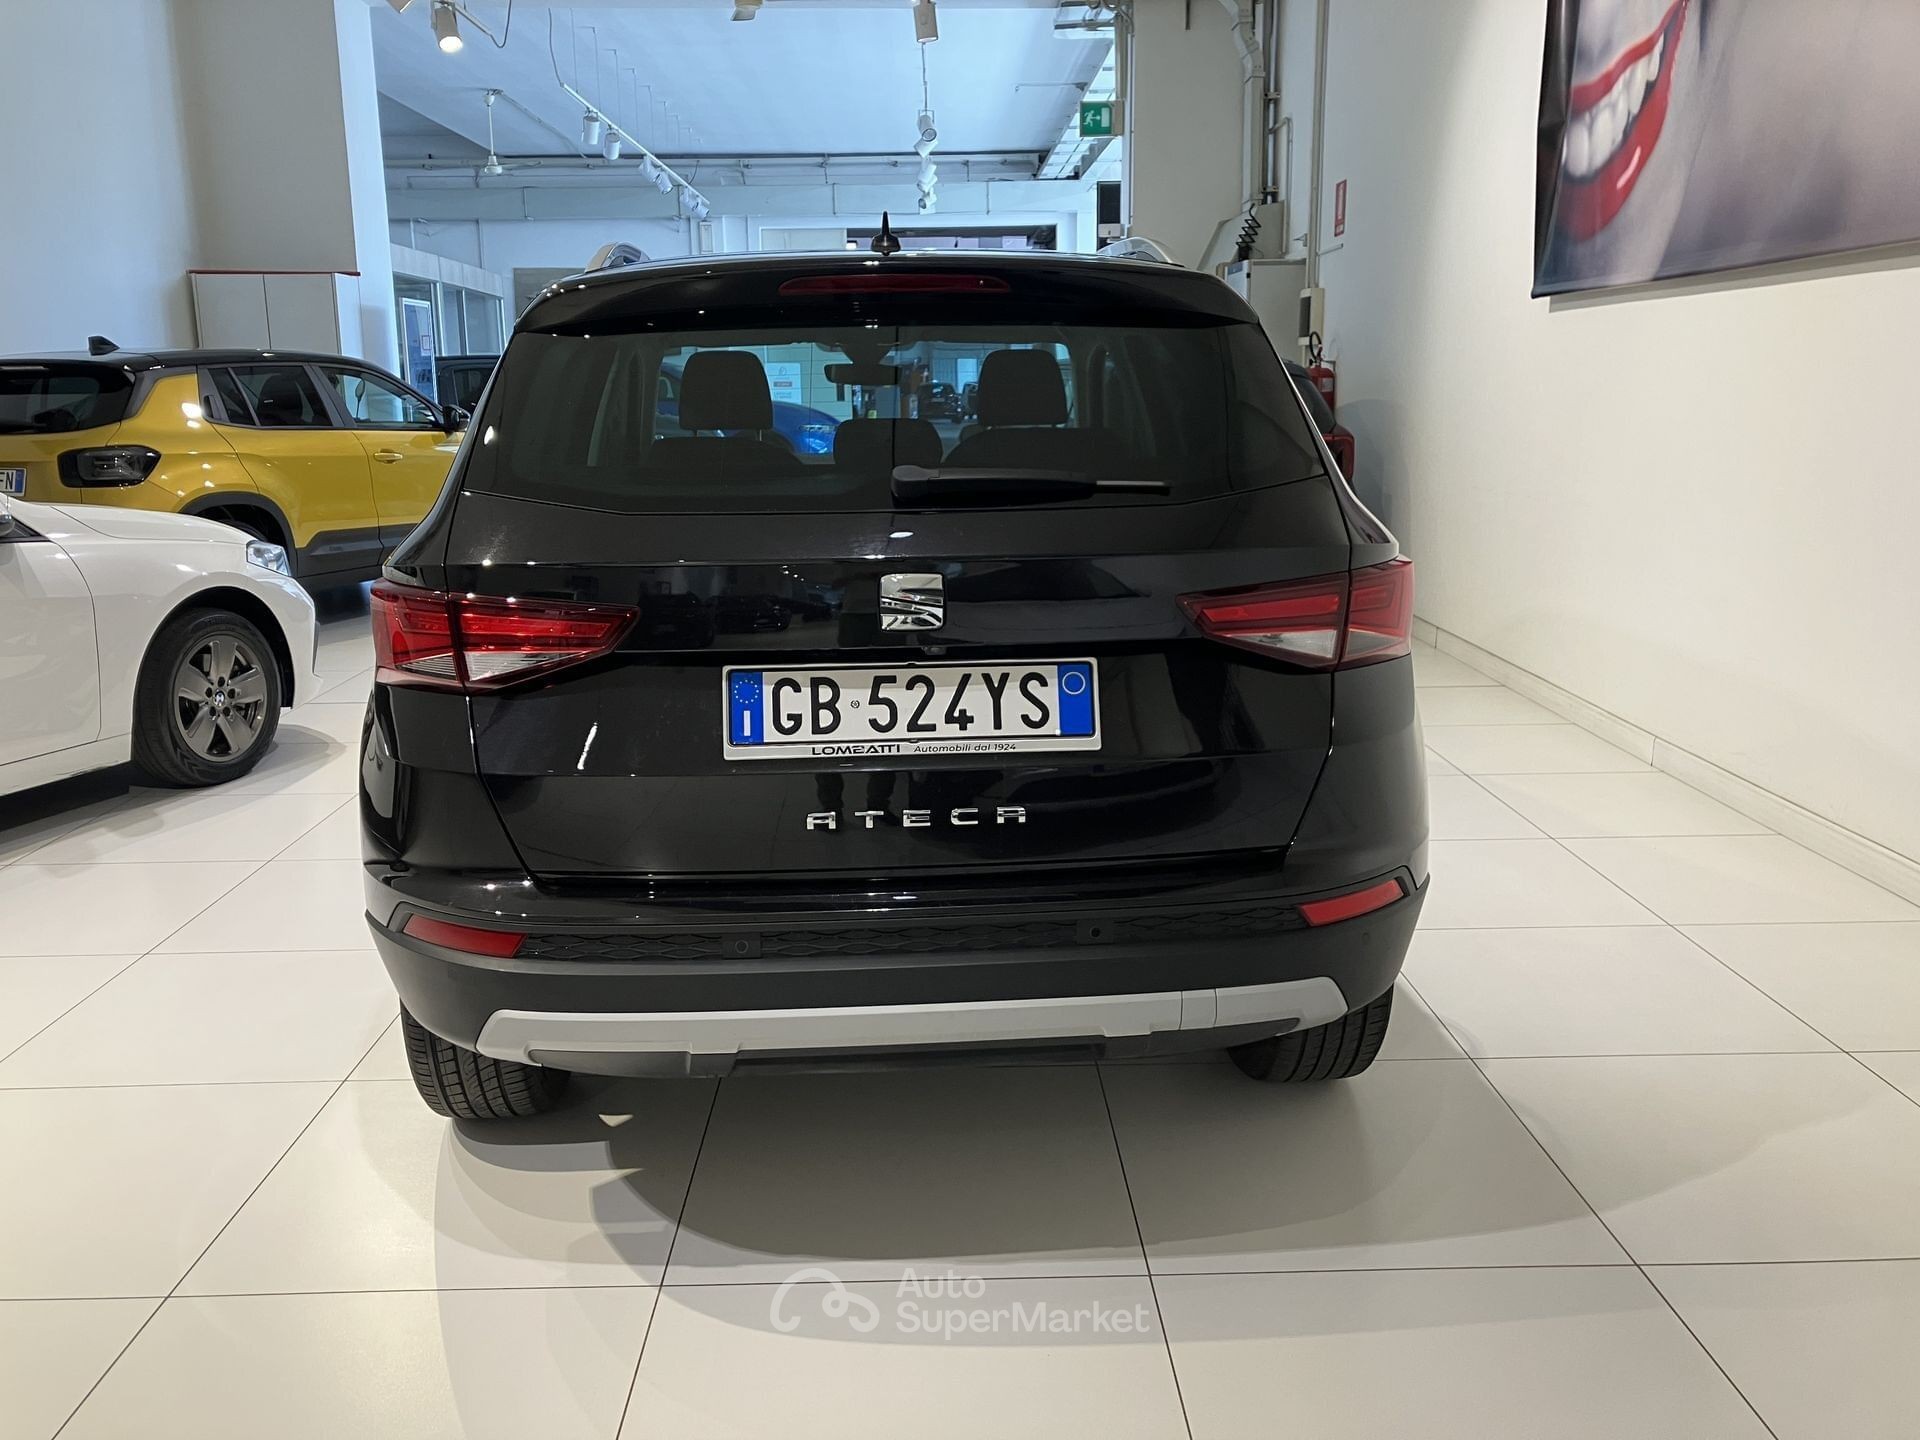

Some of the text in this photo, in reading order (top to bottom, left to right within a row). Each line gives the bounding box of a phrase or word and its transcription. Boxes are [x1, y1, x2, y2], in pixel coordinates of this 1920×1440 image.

[771, 677, 841, 735] GB
[868, 672, 1049, 733] 524YS
[913, 744, 971, 754] Automobili
[974, 744, 990, 752] dal
[994, 743, 1016, 752] 1924
[806, 806, 1026, 830] ATECA
